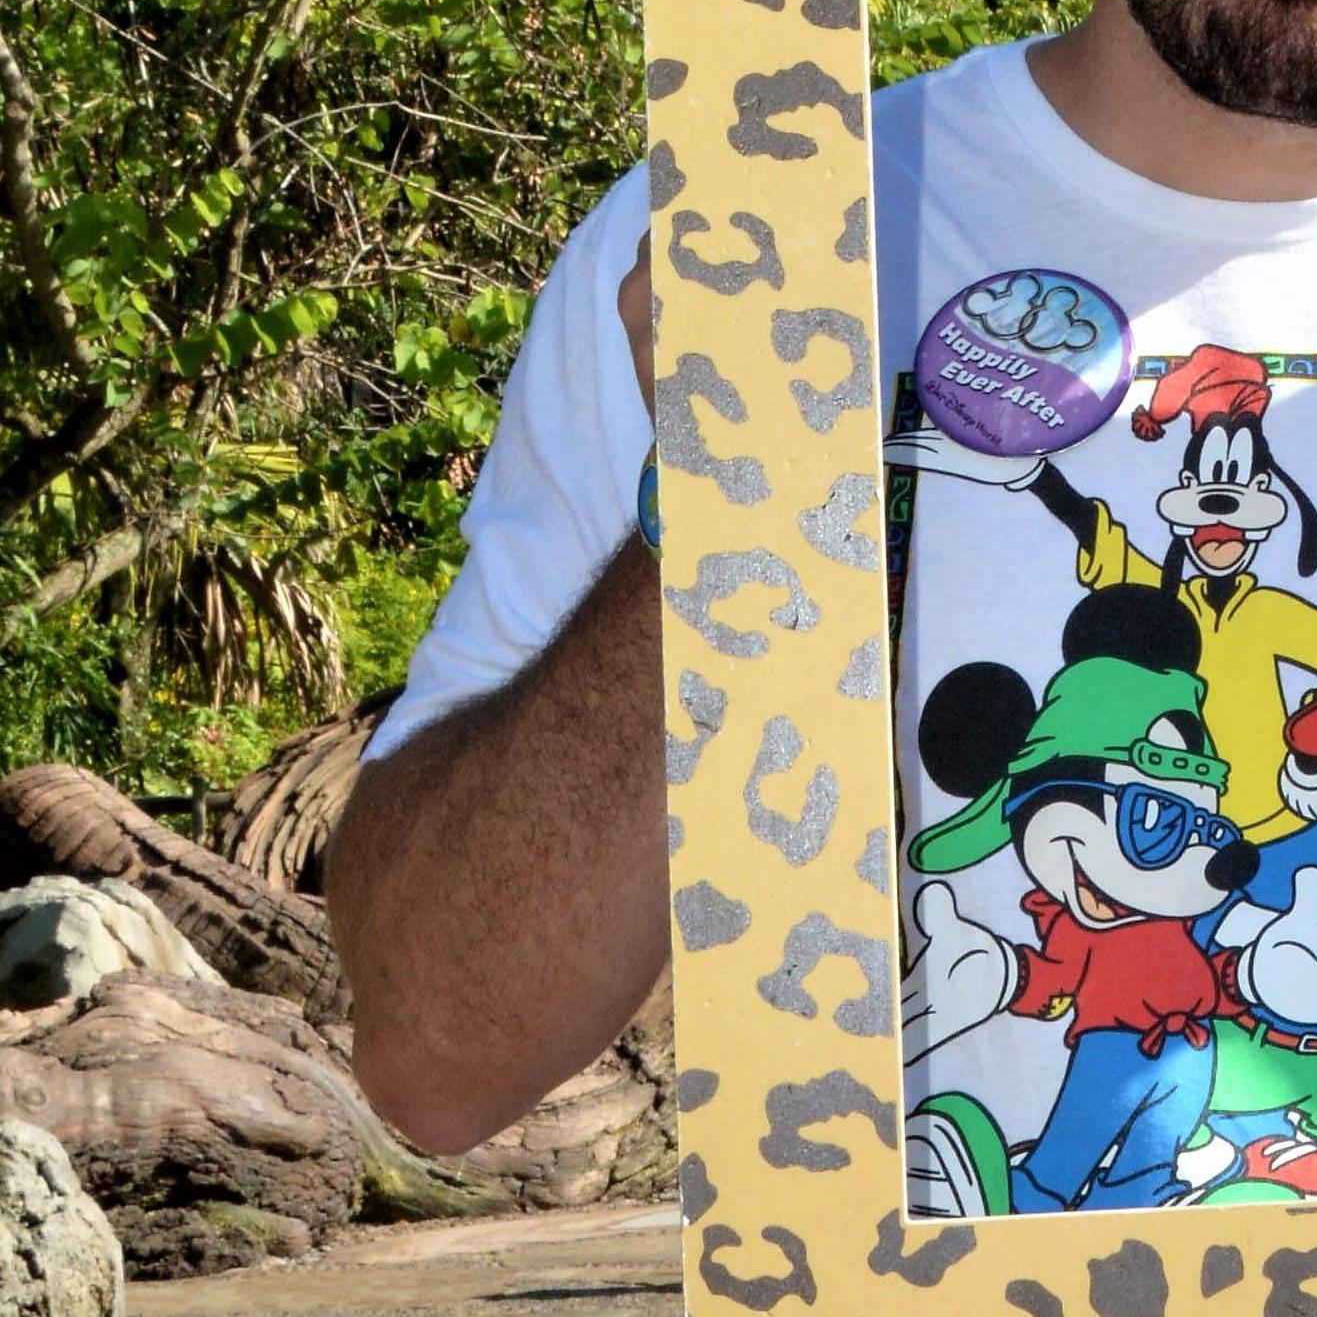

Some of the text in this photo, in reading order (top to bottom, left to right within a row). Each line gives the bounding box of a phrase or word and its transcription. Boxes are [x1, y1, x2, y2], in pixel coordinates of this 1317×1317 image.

[938, 323, 1038, 381] Happily
[940, 361, 1065, 428] Ever After
